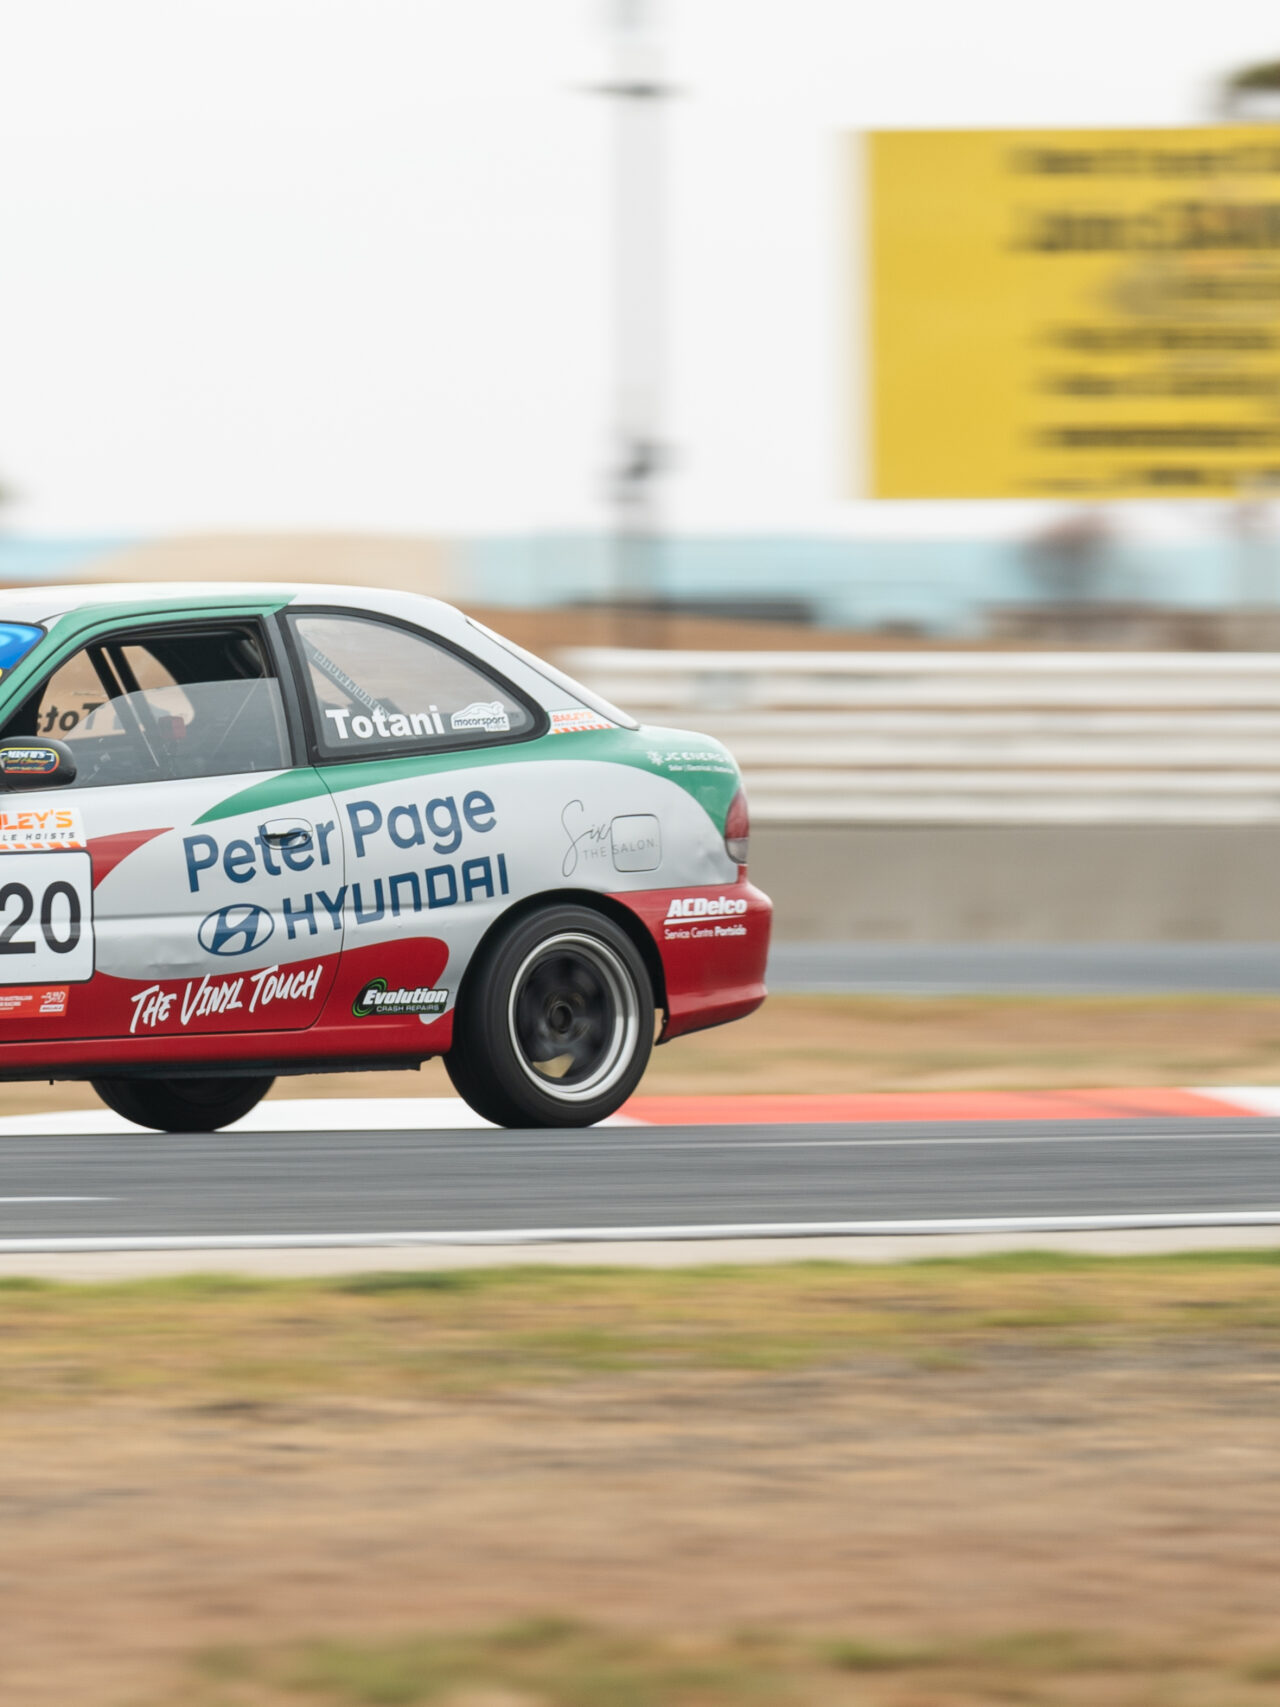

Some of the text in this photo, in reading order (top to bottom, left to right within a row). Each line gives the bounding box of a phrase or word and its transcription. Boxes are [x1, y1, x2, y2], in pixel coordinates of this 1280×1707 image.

[325, 705, 445, 739] Totani
[454, 716, 506, 727] motorsport
[26, 832, 75, 840] HOISTS
[182, 789, 498, 893] Peter Page
[583, 846, 607, 860] THE
[283, 853, 510, 940] HYUNDAI
[666, 896, 748, 917] ACDelco
[129, 964, 323, 1033] THE VINYL TOUCH
[362, 987, 448, 1005] Evolution
